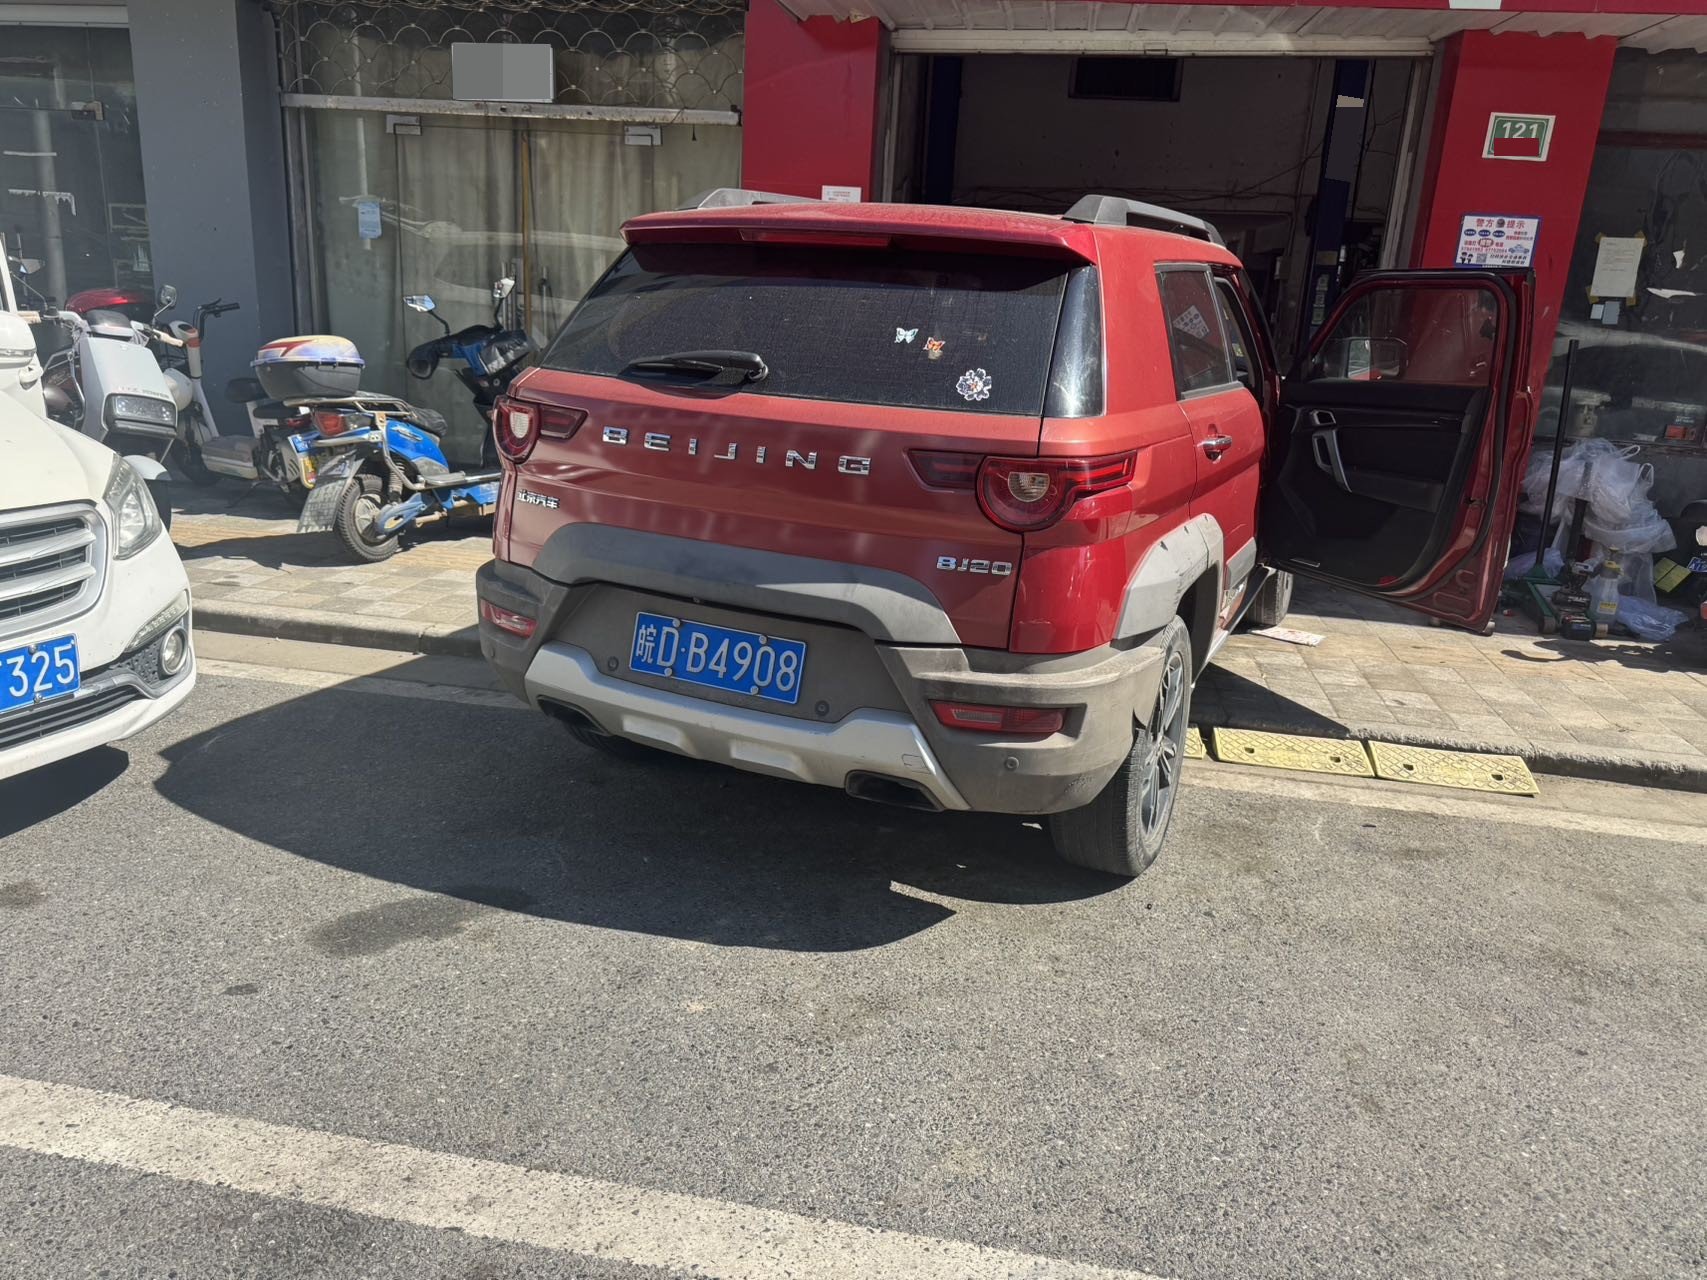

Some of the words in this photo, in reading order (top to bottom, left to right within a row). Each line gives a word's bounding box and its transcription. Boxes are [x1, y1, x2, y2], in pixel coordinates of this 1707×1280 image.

[1502, 122, 1539, 139] 121
[1476, 218, 1495, 228] 警方
[1506, 220, 1526, 229] 提示
[602, 426, 871, 475] BEIJING
[517, 490, 560, 509] 北京汽车
[936, 556, 1012, 576] BJ20
[0, 643, 75, 698] 325
